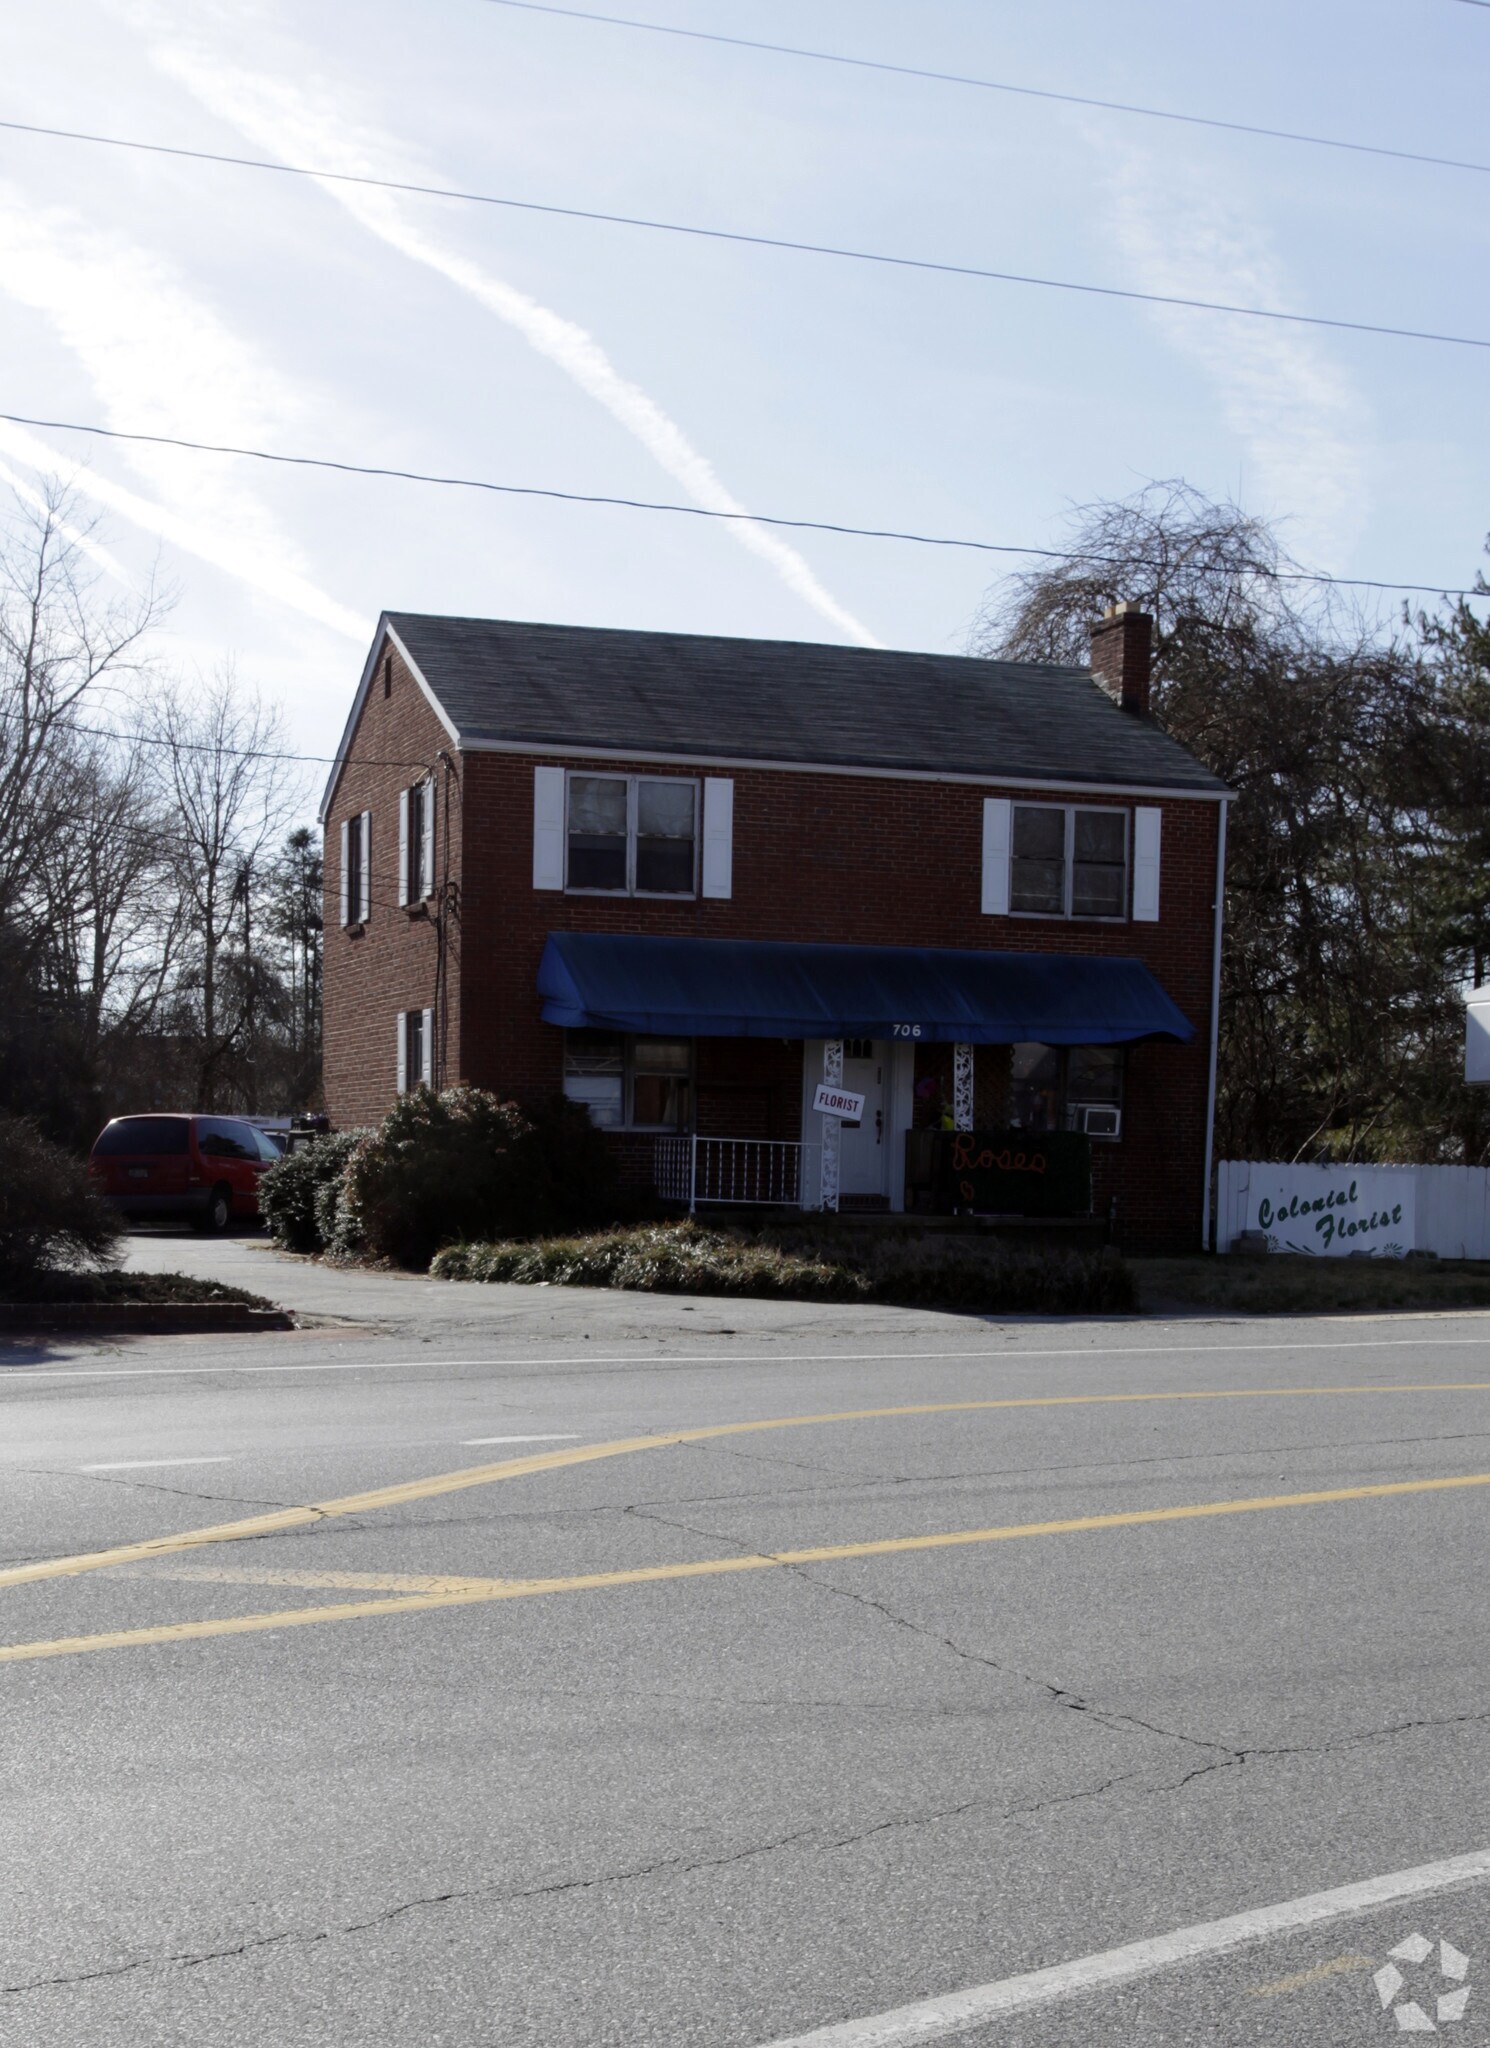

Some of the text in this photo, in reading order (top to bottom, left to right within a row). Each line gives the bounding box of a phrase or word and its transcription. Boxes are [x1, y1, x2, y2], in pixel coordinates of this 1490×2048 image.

[892, 1024, 921, 1037] 706
[818, 1092, 859, 1113] FLORIST
[952, 1133, 1047, 1174] Roses
[1258, 1181, 1358, 1229] Colonial
[1316, 1204, 1402, 1249] Florist
